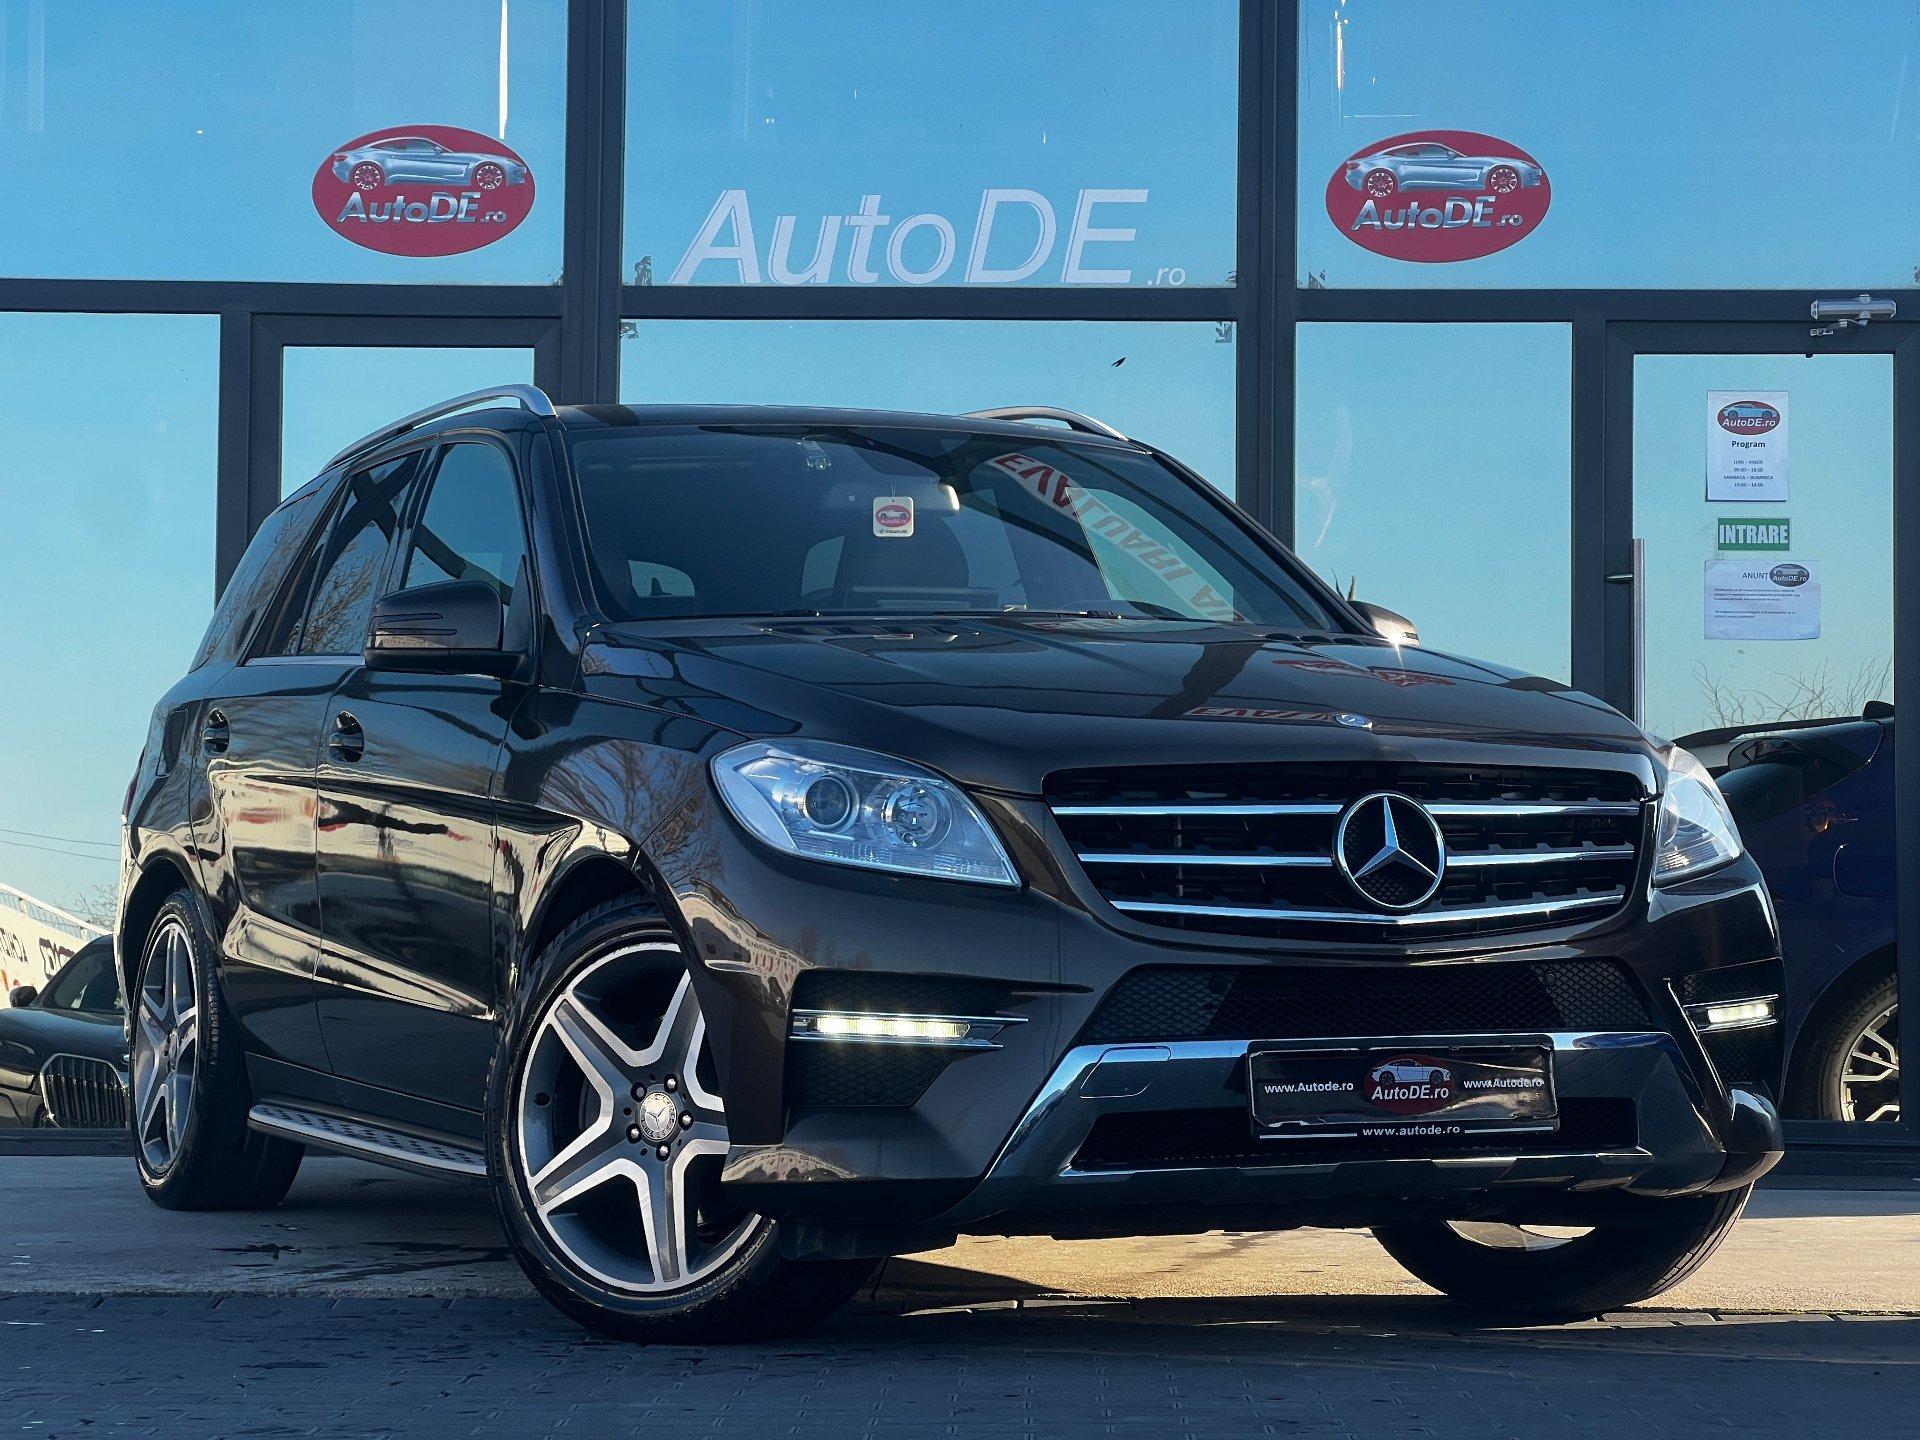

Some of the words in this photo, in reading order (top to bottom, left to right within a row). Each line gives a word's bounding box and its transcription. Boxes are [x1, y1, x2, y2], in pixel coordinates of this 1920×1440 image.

[336, 191, 507, 224] AutoDE.ro
[1350, 195, 1524, 231] AutoDE.ro
[1721, 418, 1776, 428] AutoDE.ro
[1731, 440, 1766, 449] Program
[1719, 524, 1789, 545] INTRARE
[1264, 1081, 1354, 1094] www.Autode.ro
[1371, 1084, 1449, 1101] AutoDE.ro
[1362, 1125, 1461, 1136] www.autode.ro
